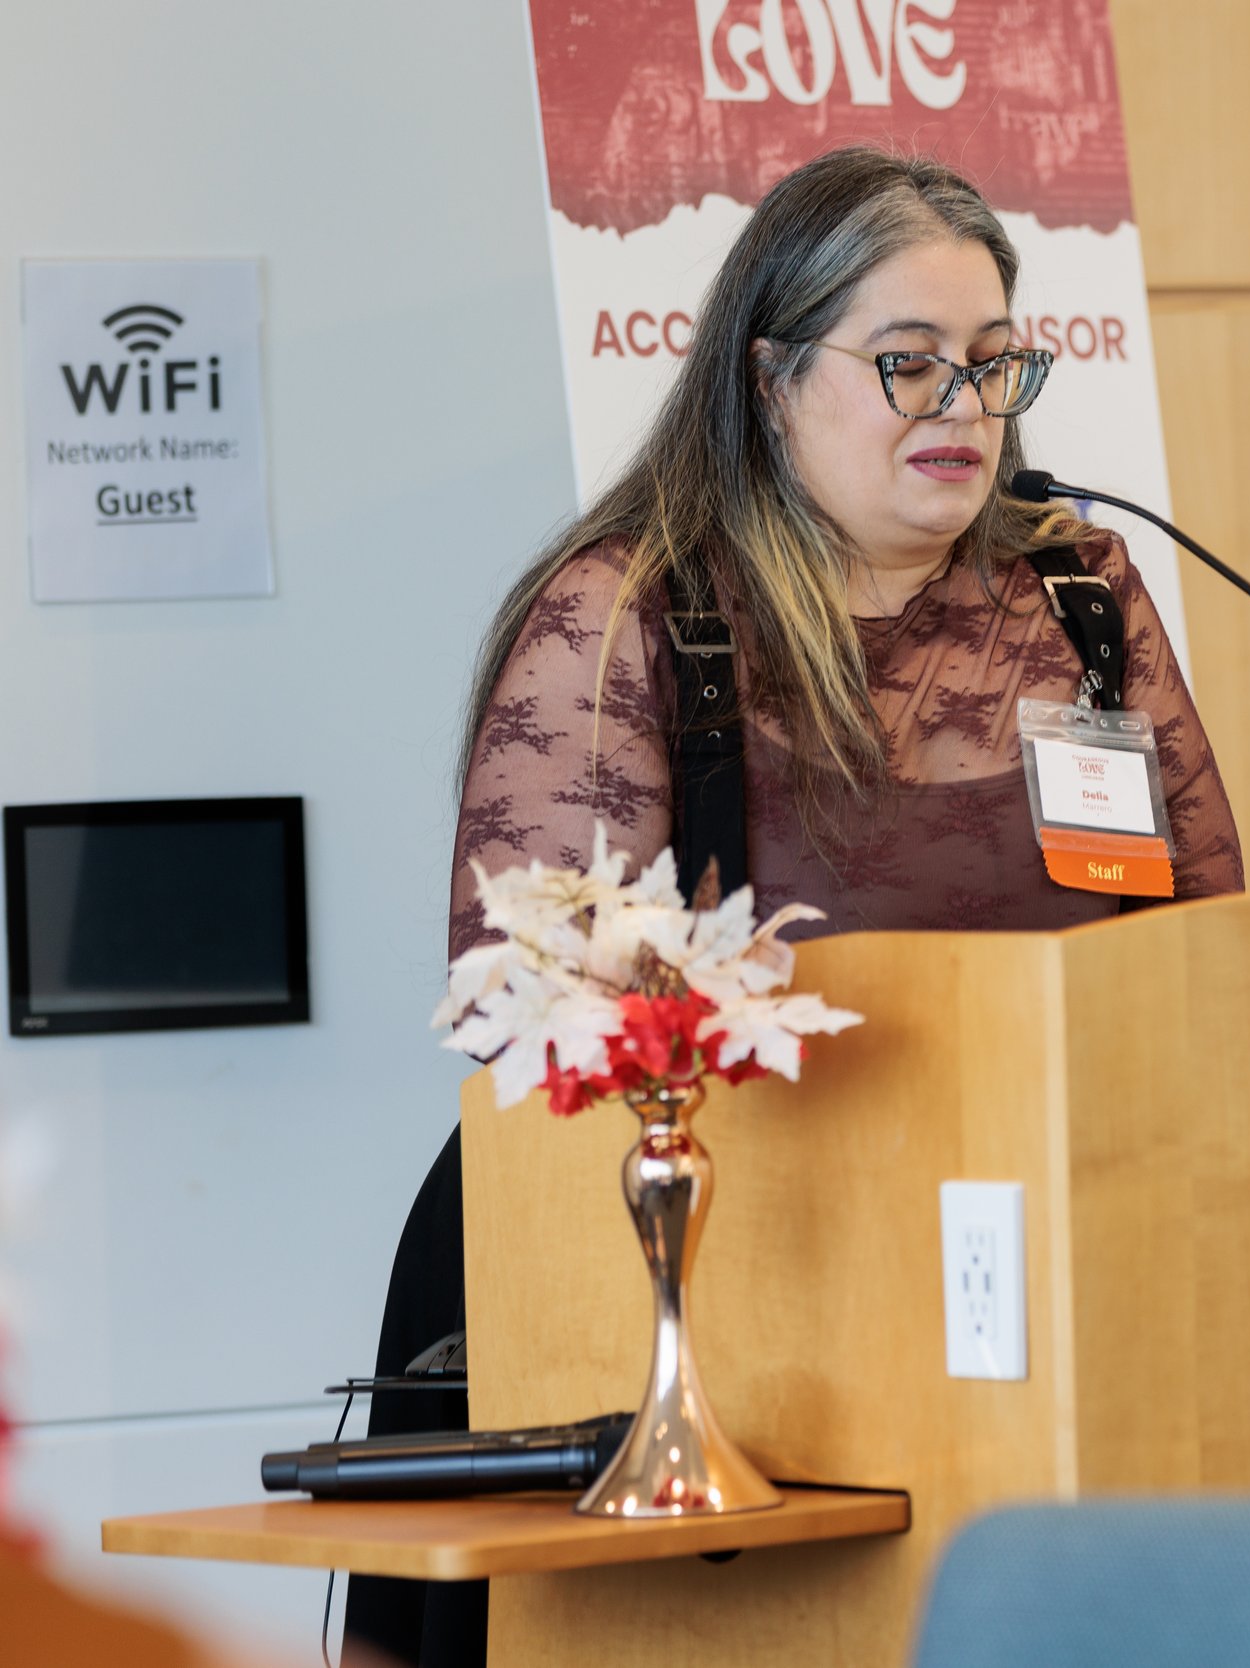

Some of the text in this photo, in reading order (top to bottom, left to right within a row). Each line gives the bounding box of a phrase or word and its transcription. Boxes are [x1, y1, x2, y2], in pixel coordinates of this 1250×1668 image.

[696, 0, 967, 110] LOVE
[592, 310, 1127, 360] ACC NSOR
[61, 356, 221, 415] WiFi
[48, 436, 240, 465] Network Name:
[97, 484, 197, 517] Guest
[1087, 861, 1125, 881] Staff
